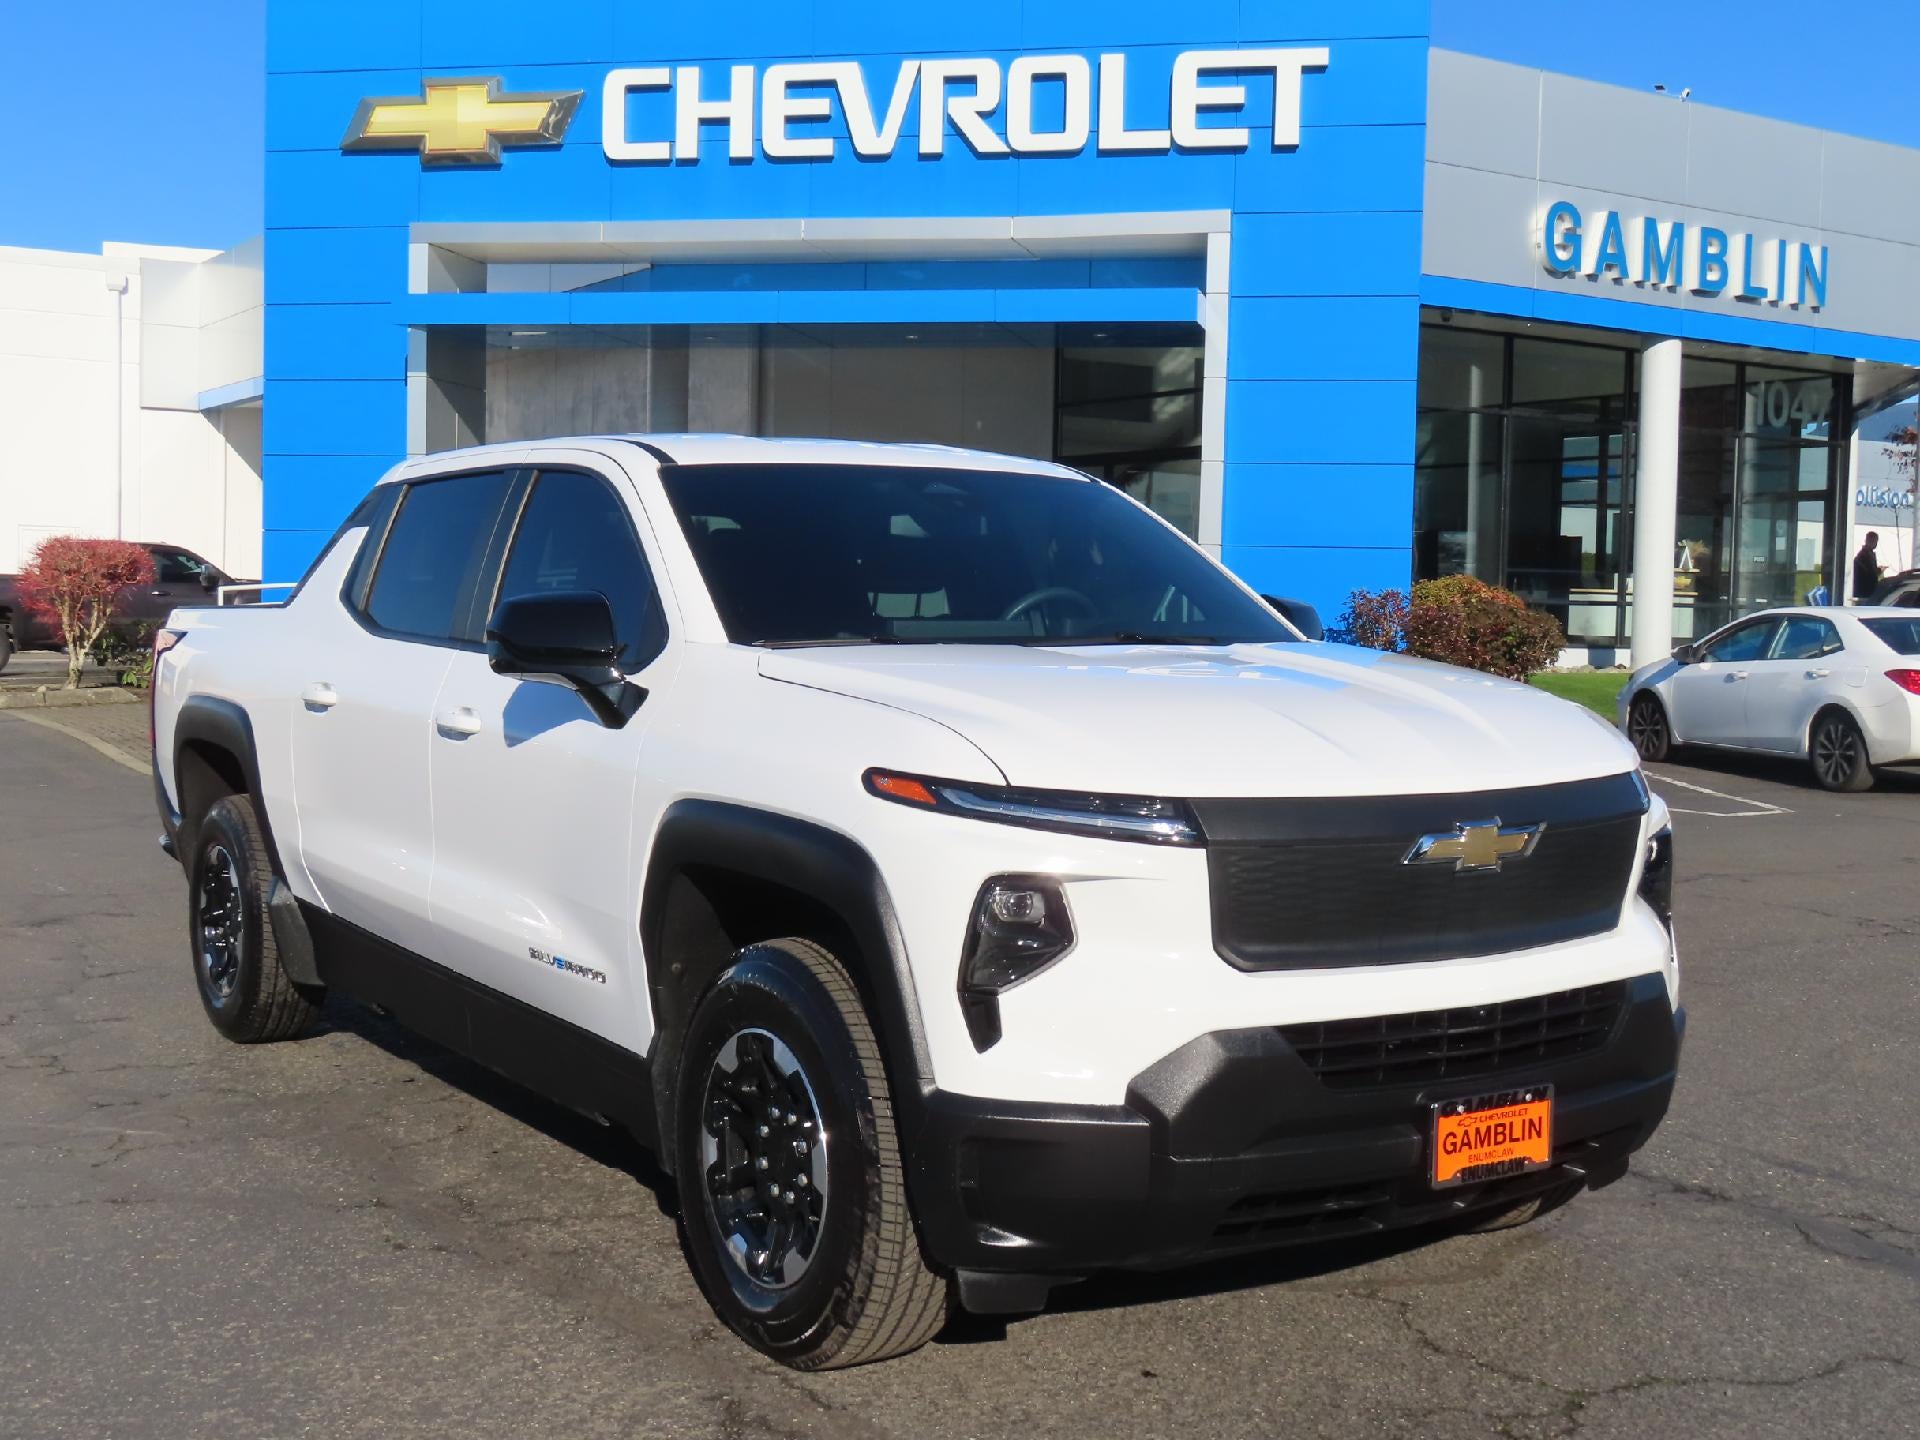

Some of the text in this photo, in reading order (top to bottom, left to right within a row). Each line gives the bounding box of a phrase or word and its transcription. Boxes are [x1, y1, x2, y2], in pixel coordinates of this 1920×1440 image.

[602, 47, 1329, 162] CHEVROLET
[1541, 200, 1829, 312] GAMBLIN
[1856, 485, 1910, 508] ollision
[1479, 1107, 1529, 1123] CHEVROLET
[1443, 1116, 1543, 1156] GAMBLIN
